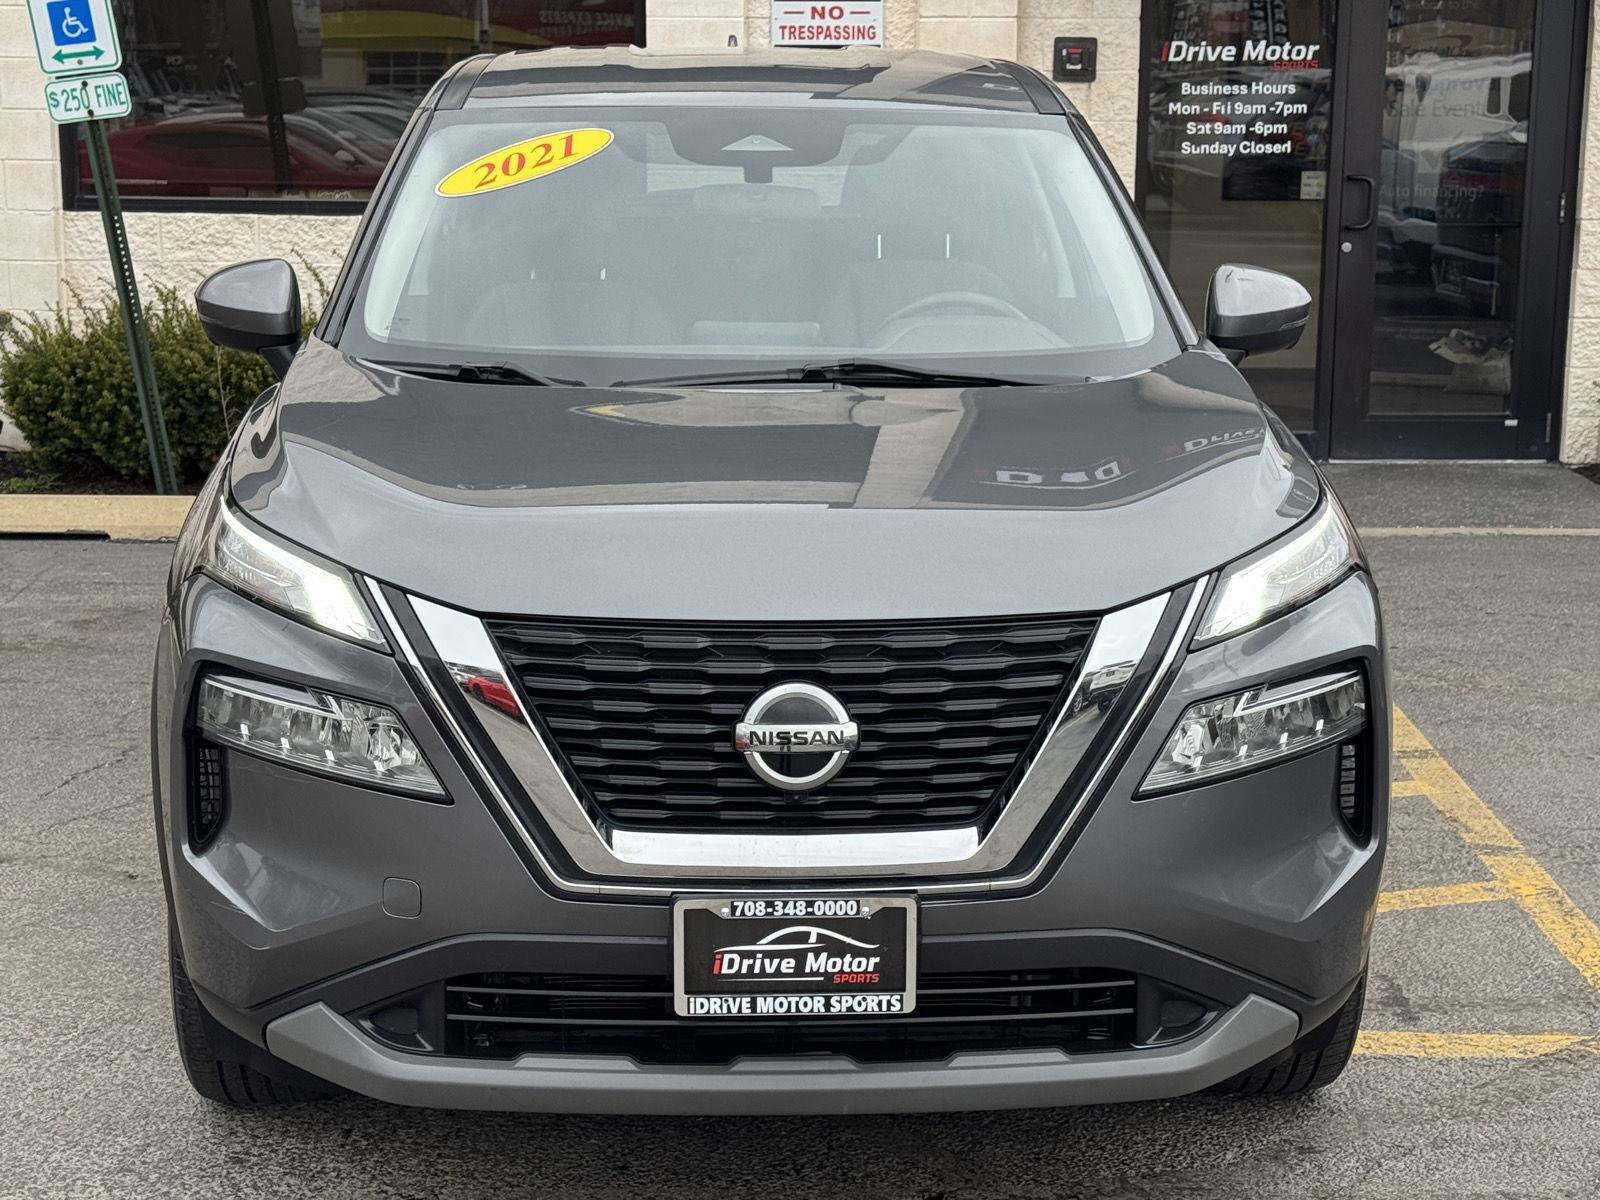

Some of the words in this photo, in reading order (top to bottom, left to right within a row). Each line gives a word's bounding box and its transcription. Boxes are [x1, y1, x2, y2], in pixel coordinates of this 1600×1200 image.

[811, 6, 844, 20] NO
[779, 25, 876, 40] TRESPASSING
[1243, 40, 1320, 62] Motor
[94, 83, 127, 108] FINE
[1181, 82, 1248, 95] Business
[1251, 82, 1296, 95] Hours
[1168, 102, 1200, 115] Mon
[1212, 102, 1232, 115] Fri
[1234, 102, 1267, 115] 9am
[1186, 122, 1211, 135] Sat
[1214, 122, 1246, 135] 9am
[1181, 142, 1236, 157] Sunday
[1239, 141, 1292, 154] Closed
[474, 134, 578, 189] 2021
[749, 730, 844, 745] NISSAN
[733, 900, 858, 917] 708-348-0000
[713, 953, 795, 974] iDrive
[804, 952, 880, 973] Motor
[832, 973, 880, 984] SPORTS
[756, 997, 826, 1014] MOTOR
[829, 995, 901, 1013] SPORTS
